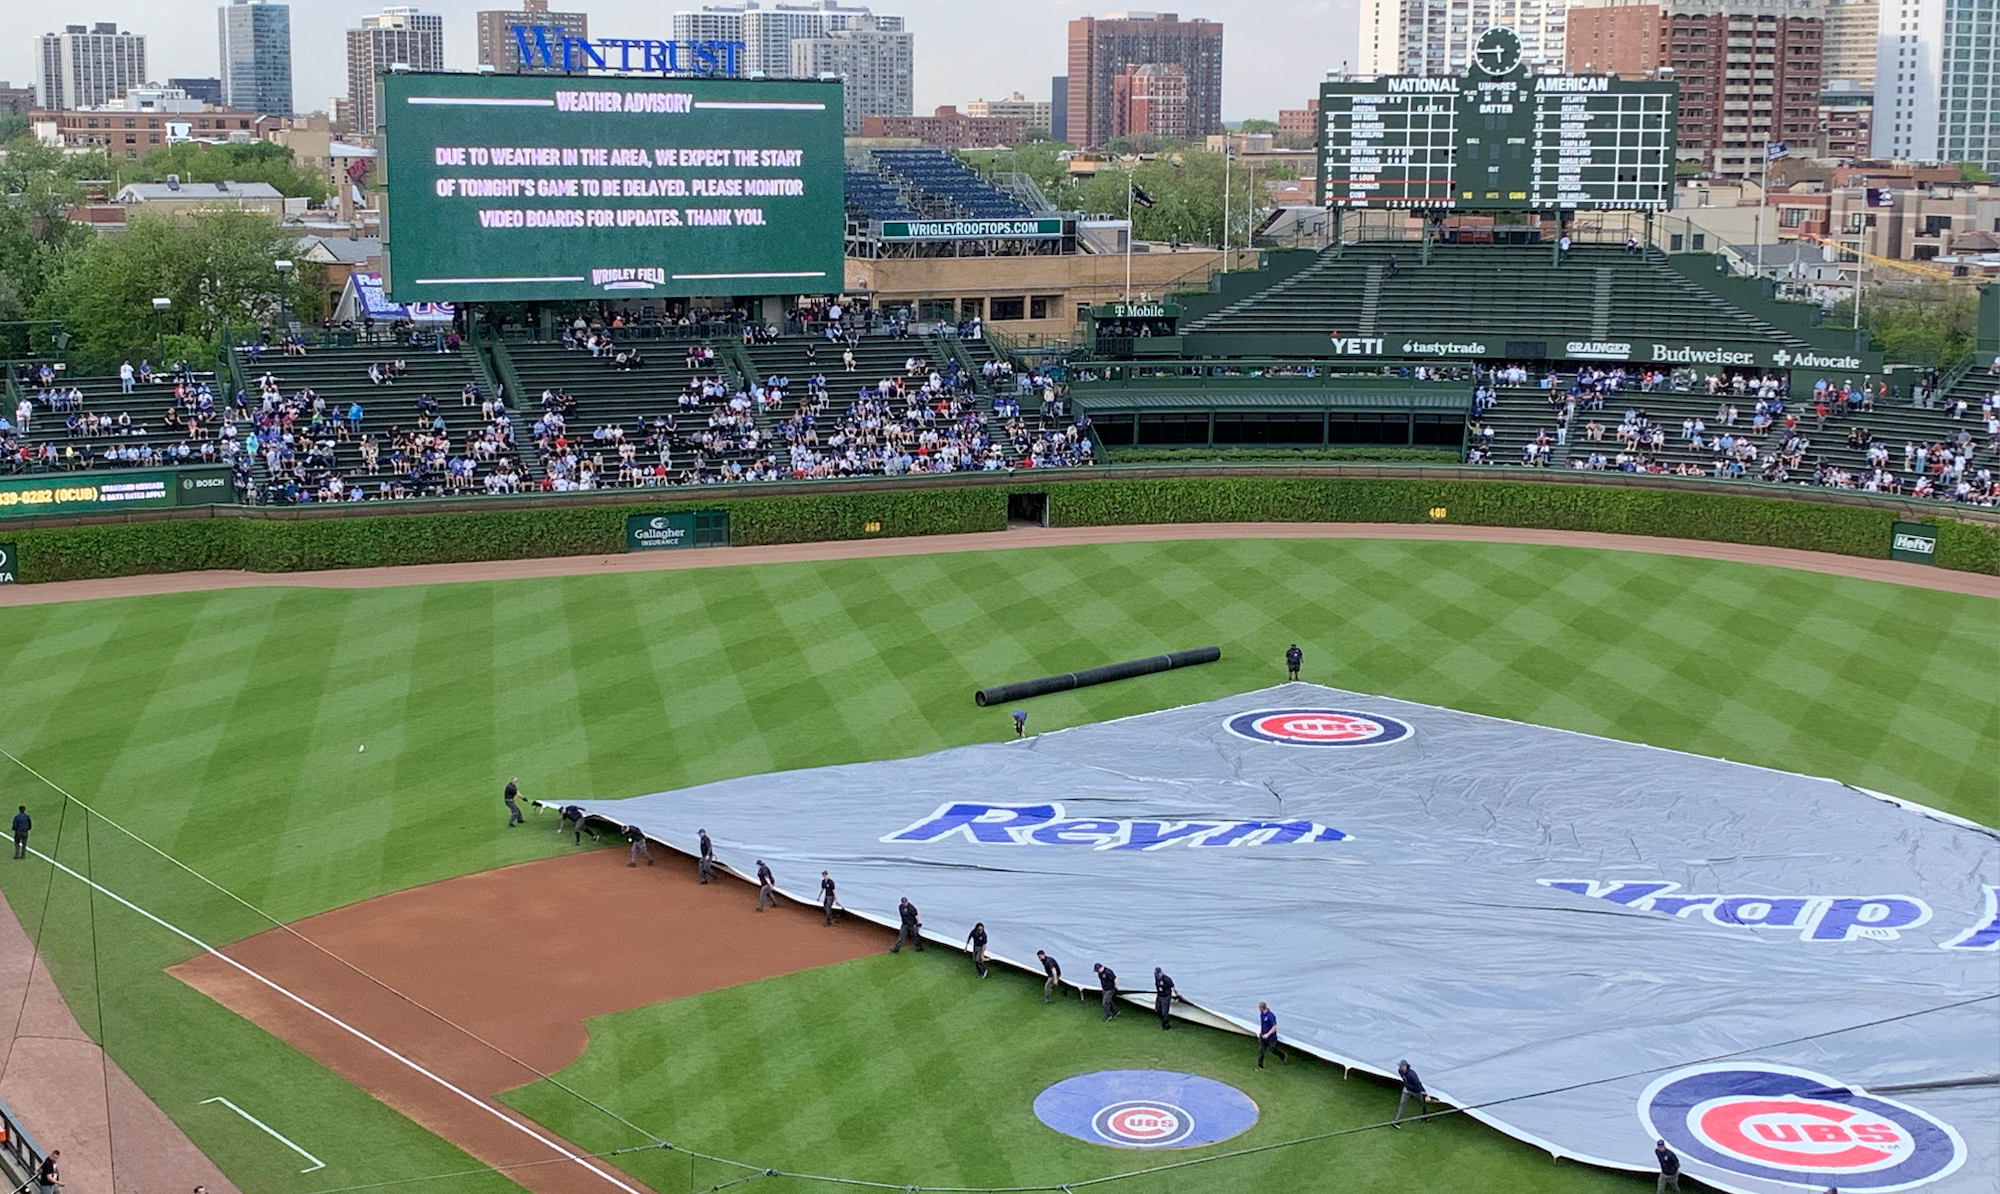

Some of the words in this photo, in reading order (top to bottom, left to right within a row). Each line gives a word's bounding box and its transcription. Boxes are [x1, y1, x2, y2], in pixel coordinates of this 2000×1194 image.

[510, 26, 746, 74] WINTRUST
[1388, 78, 1460, 92] NATIONAL
[1478, 82, 1517, 91] UMPIRES
[1534, 78, 1608, 91] AMERICAN
[556, 92, 622, 112] WEATHER
[624, 93, 693, 113] ADVISORY
[1479, 104, 1513, 113] BATTER
[436, 148, 466, 165] DUE
[468, 148, 488, 165] TO
[491, 148, 560, 165] WEATHER
[563, 149, 577, 165] IN
[580, 149, 608, 166] THE
[610, 149, 652, 168] AREA,
[655, 149, 678, 166] WE
[679, 150, 730, 166] EXPECT
[733, 150, 759, 166] THE
[761, 150, 803, 167] START
[436, 179, 456, 197] OF
[458, 179, 535, 197] TONIGHT'S
[538, 179, 578, 196] GAME
[581, 179, 599, 196] TO
[602, 179, 621, 196] BE
[623, 179, 689, 196] DELAYED.
[692, 179, 743, 196] PLEASE
[744, 179, 803, 196] MONITOR
[1386, 200, 1390, 208] 1
[1392, 200, 1397, 208] 2
[1401, 200, 1405, 208] 3
[1406, 200, 1412, 208] 4
[1414, 200, 1419, 208] 5
[1421, 200, 1426, 208] 6
[1428, 200, 1433, 208] 7
[1435, 200, 1440, 208] 8
[1442, 200, 1447, 208] 9
[479, 210, 523, 227] VIDEO
[526, 210, 584, 227] BOARDS
[587, 210, 614, 227] FOR
[617, 209, 683, 227] UPDATES.
[686, 209, 732, 226] THANK
[734, 209, 766, 226] YOU.
[592, 268, 635, 285] WRIGLEY
[638, 267, 665, 284] FIELD
[1127, 305, 1164, 317] Mobile
[1331, 338, 1383, 355] YETI
[1413, 342, 1486, 356] tastytrade
[1566, 342, 1632, 354] GRAINGER
[1652, 344, 1752, 364] Budweiser
[1793, 352, 1860, 369] Advocate
[196, 479, 224, 487] BOSCH
[0, 489, 53, 506] 39-0282
[107, 493, 124, 501] DATA
[1429, 507, 1446, 518] 400
[634, 528, 685, 539] Gallagher
[641, 538, 679, 546] INSURANCE
[1896, 536, 1933, 552] Hefty
[878, 802, 1356, 851] Reyn
[1112, 1108, 1174, 1136] CUBS
[1700, 1099, 1901, 1168] CUBS
